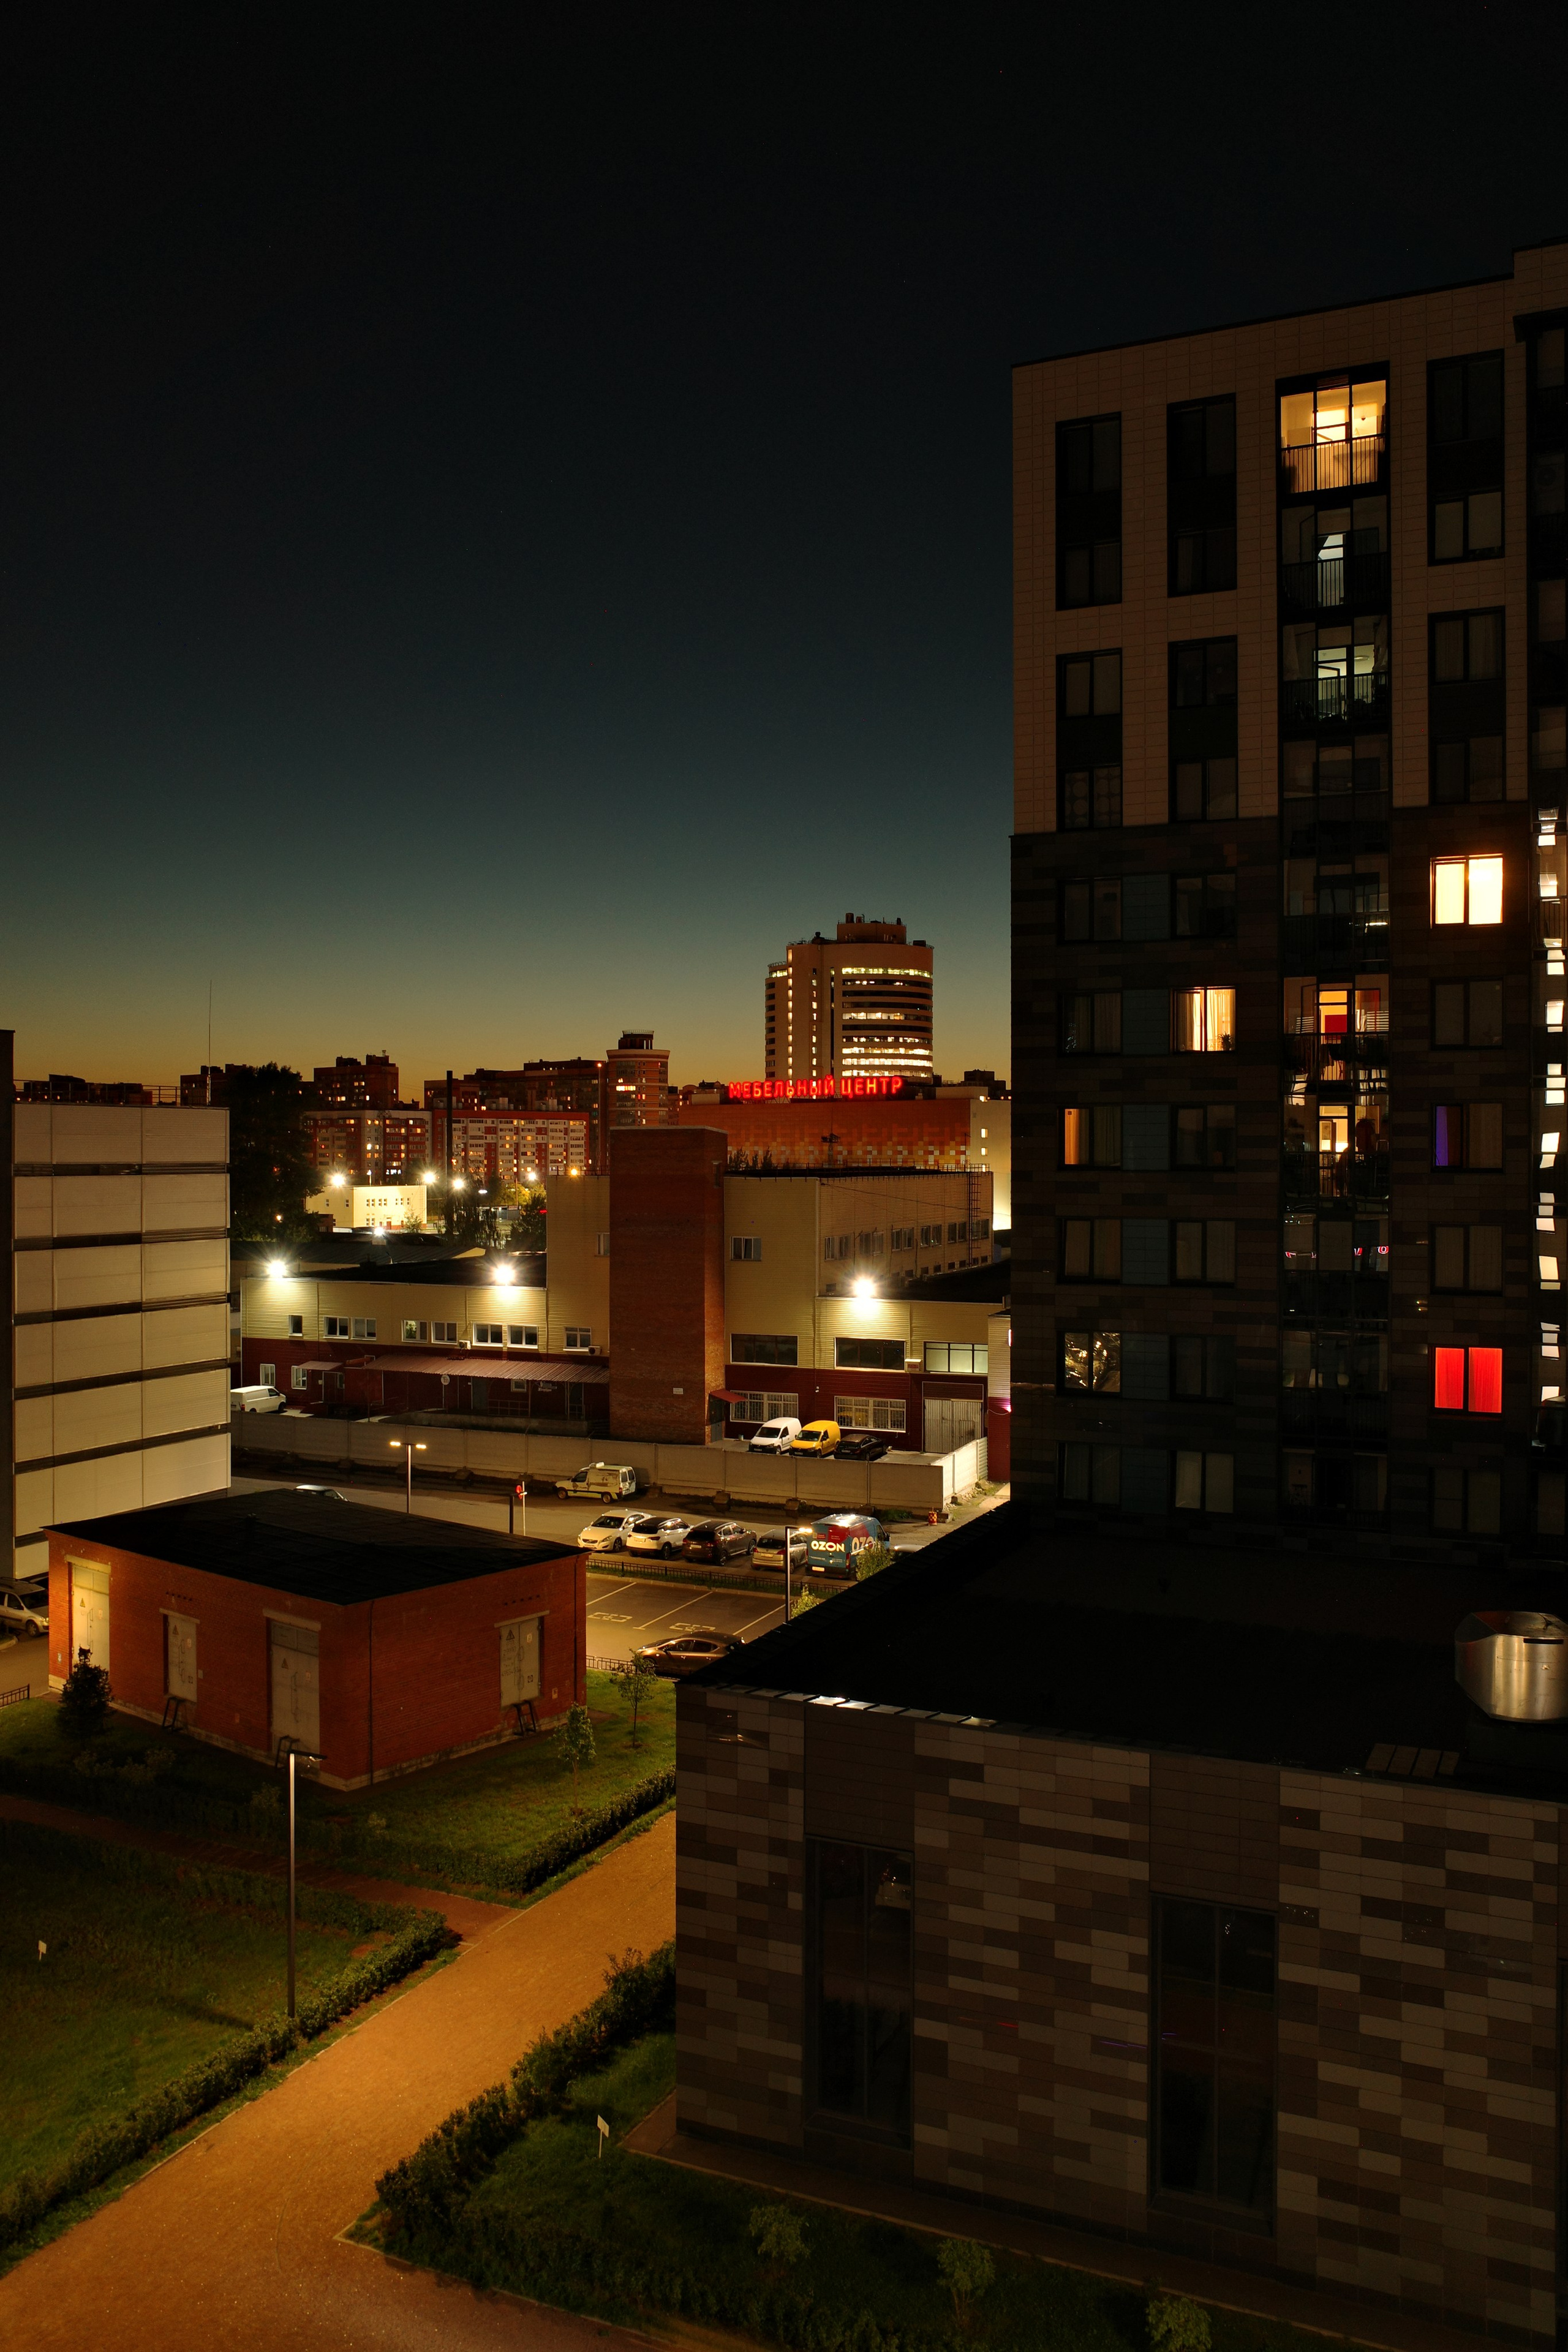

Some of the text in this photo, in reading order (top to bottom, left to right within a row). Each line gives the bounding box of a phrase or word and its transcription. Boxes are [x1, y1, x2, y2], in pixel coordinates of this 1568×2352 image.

[729, 1074, 903, 1098] МЕБЕЛЬНЫЙ ЦЕНТР
[811, 1540, 845, 1553] OZON
[852, 1536, 875, 1555] OZO
